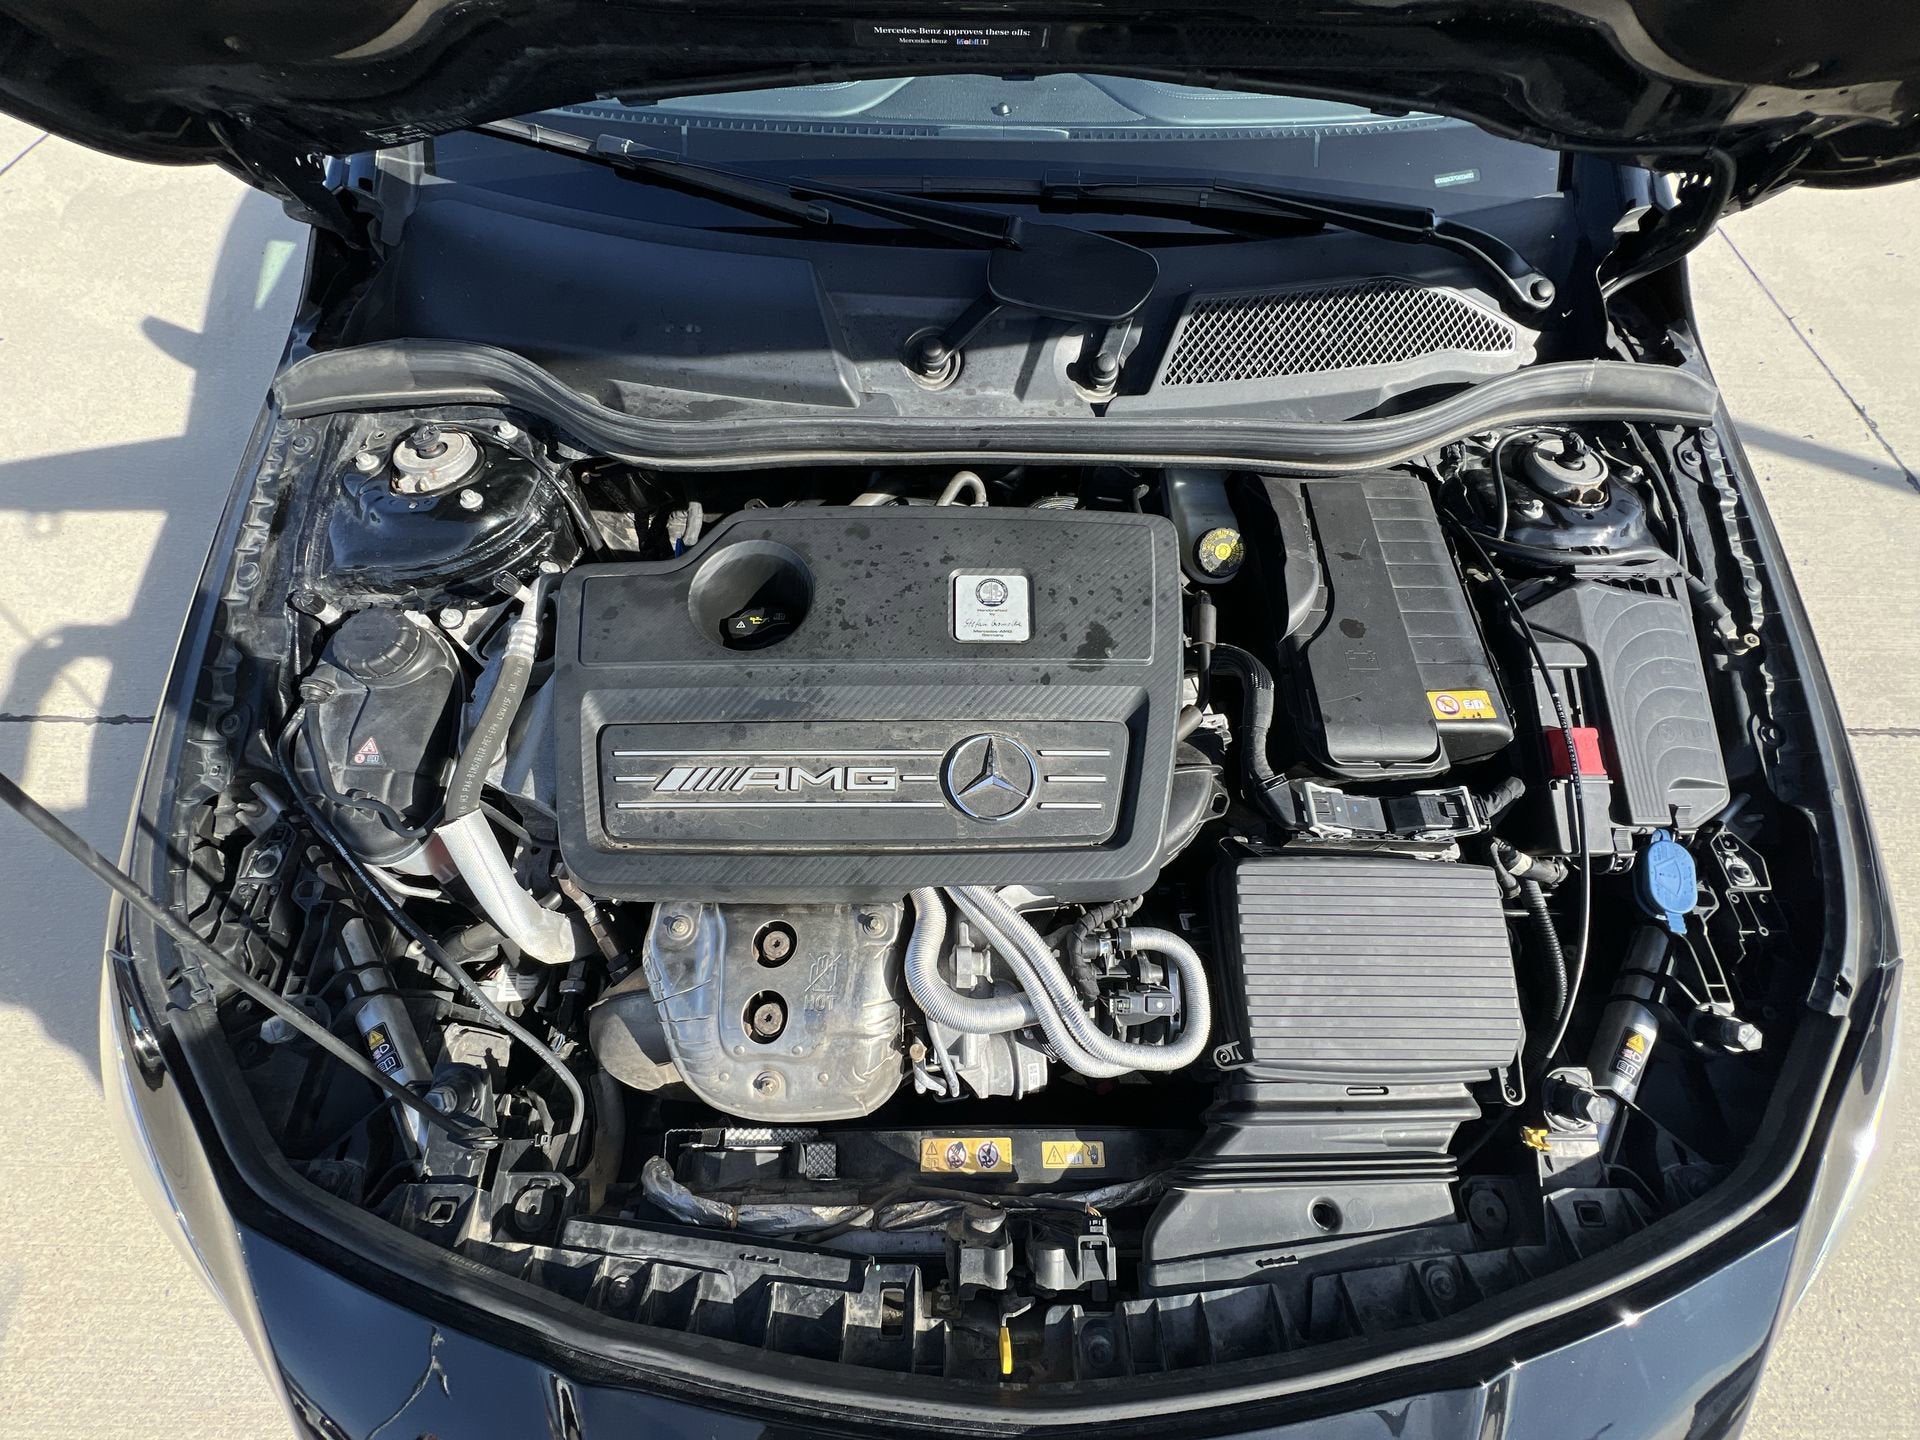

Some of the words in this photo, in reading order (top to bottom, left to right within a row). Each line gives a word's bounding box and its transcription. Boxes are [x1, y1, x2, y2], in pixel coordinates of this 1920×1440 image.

[873, 26, 941, 35] Mercedes-Benz
[943, 28, 983, 36] approves
[985, 28, 1010, 36] these
[729, 766, 897, 791] AMG
[803, 994, 841, 1011] HOT
